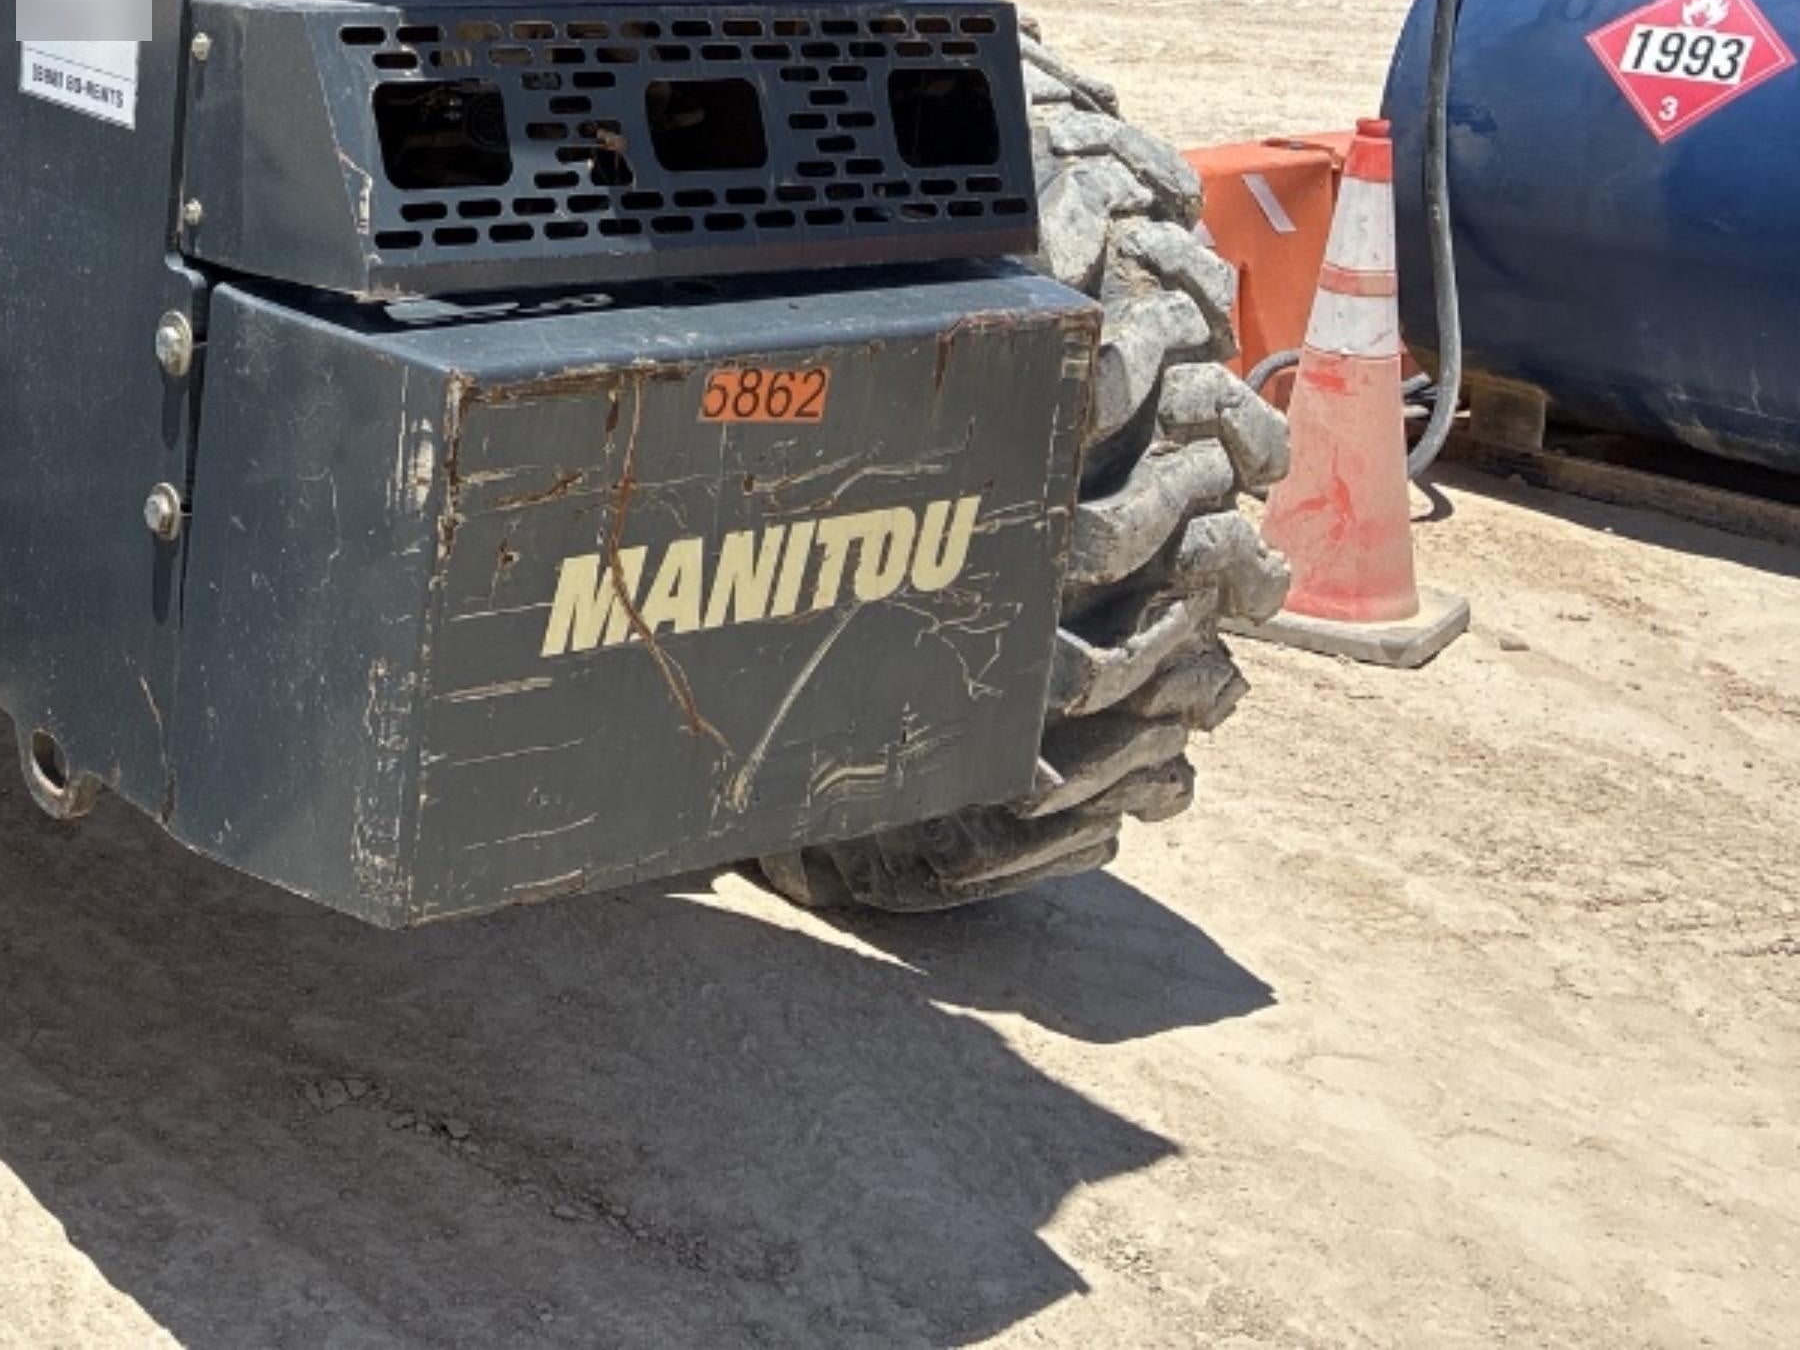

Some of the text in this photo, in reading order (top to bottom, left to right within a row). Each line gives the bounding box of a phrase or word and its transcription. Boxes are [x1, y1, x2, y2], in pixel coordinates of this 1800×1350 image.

[1631, 29, 1745, 80] 1993
[1658, 95, 1679, 122] 3
[703, 367, 826, 418] 5862
[539, 494, 982, 658] MANITOU
